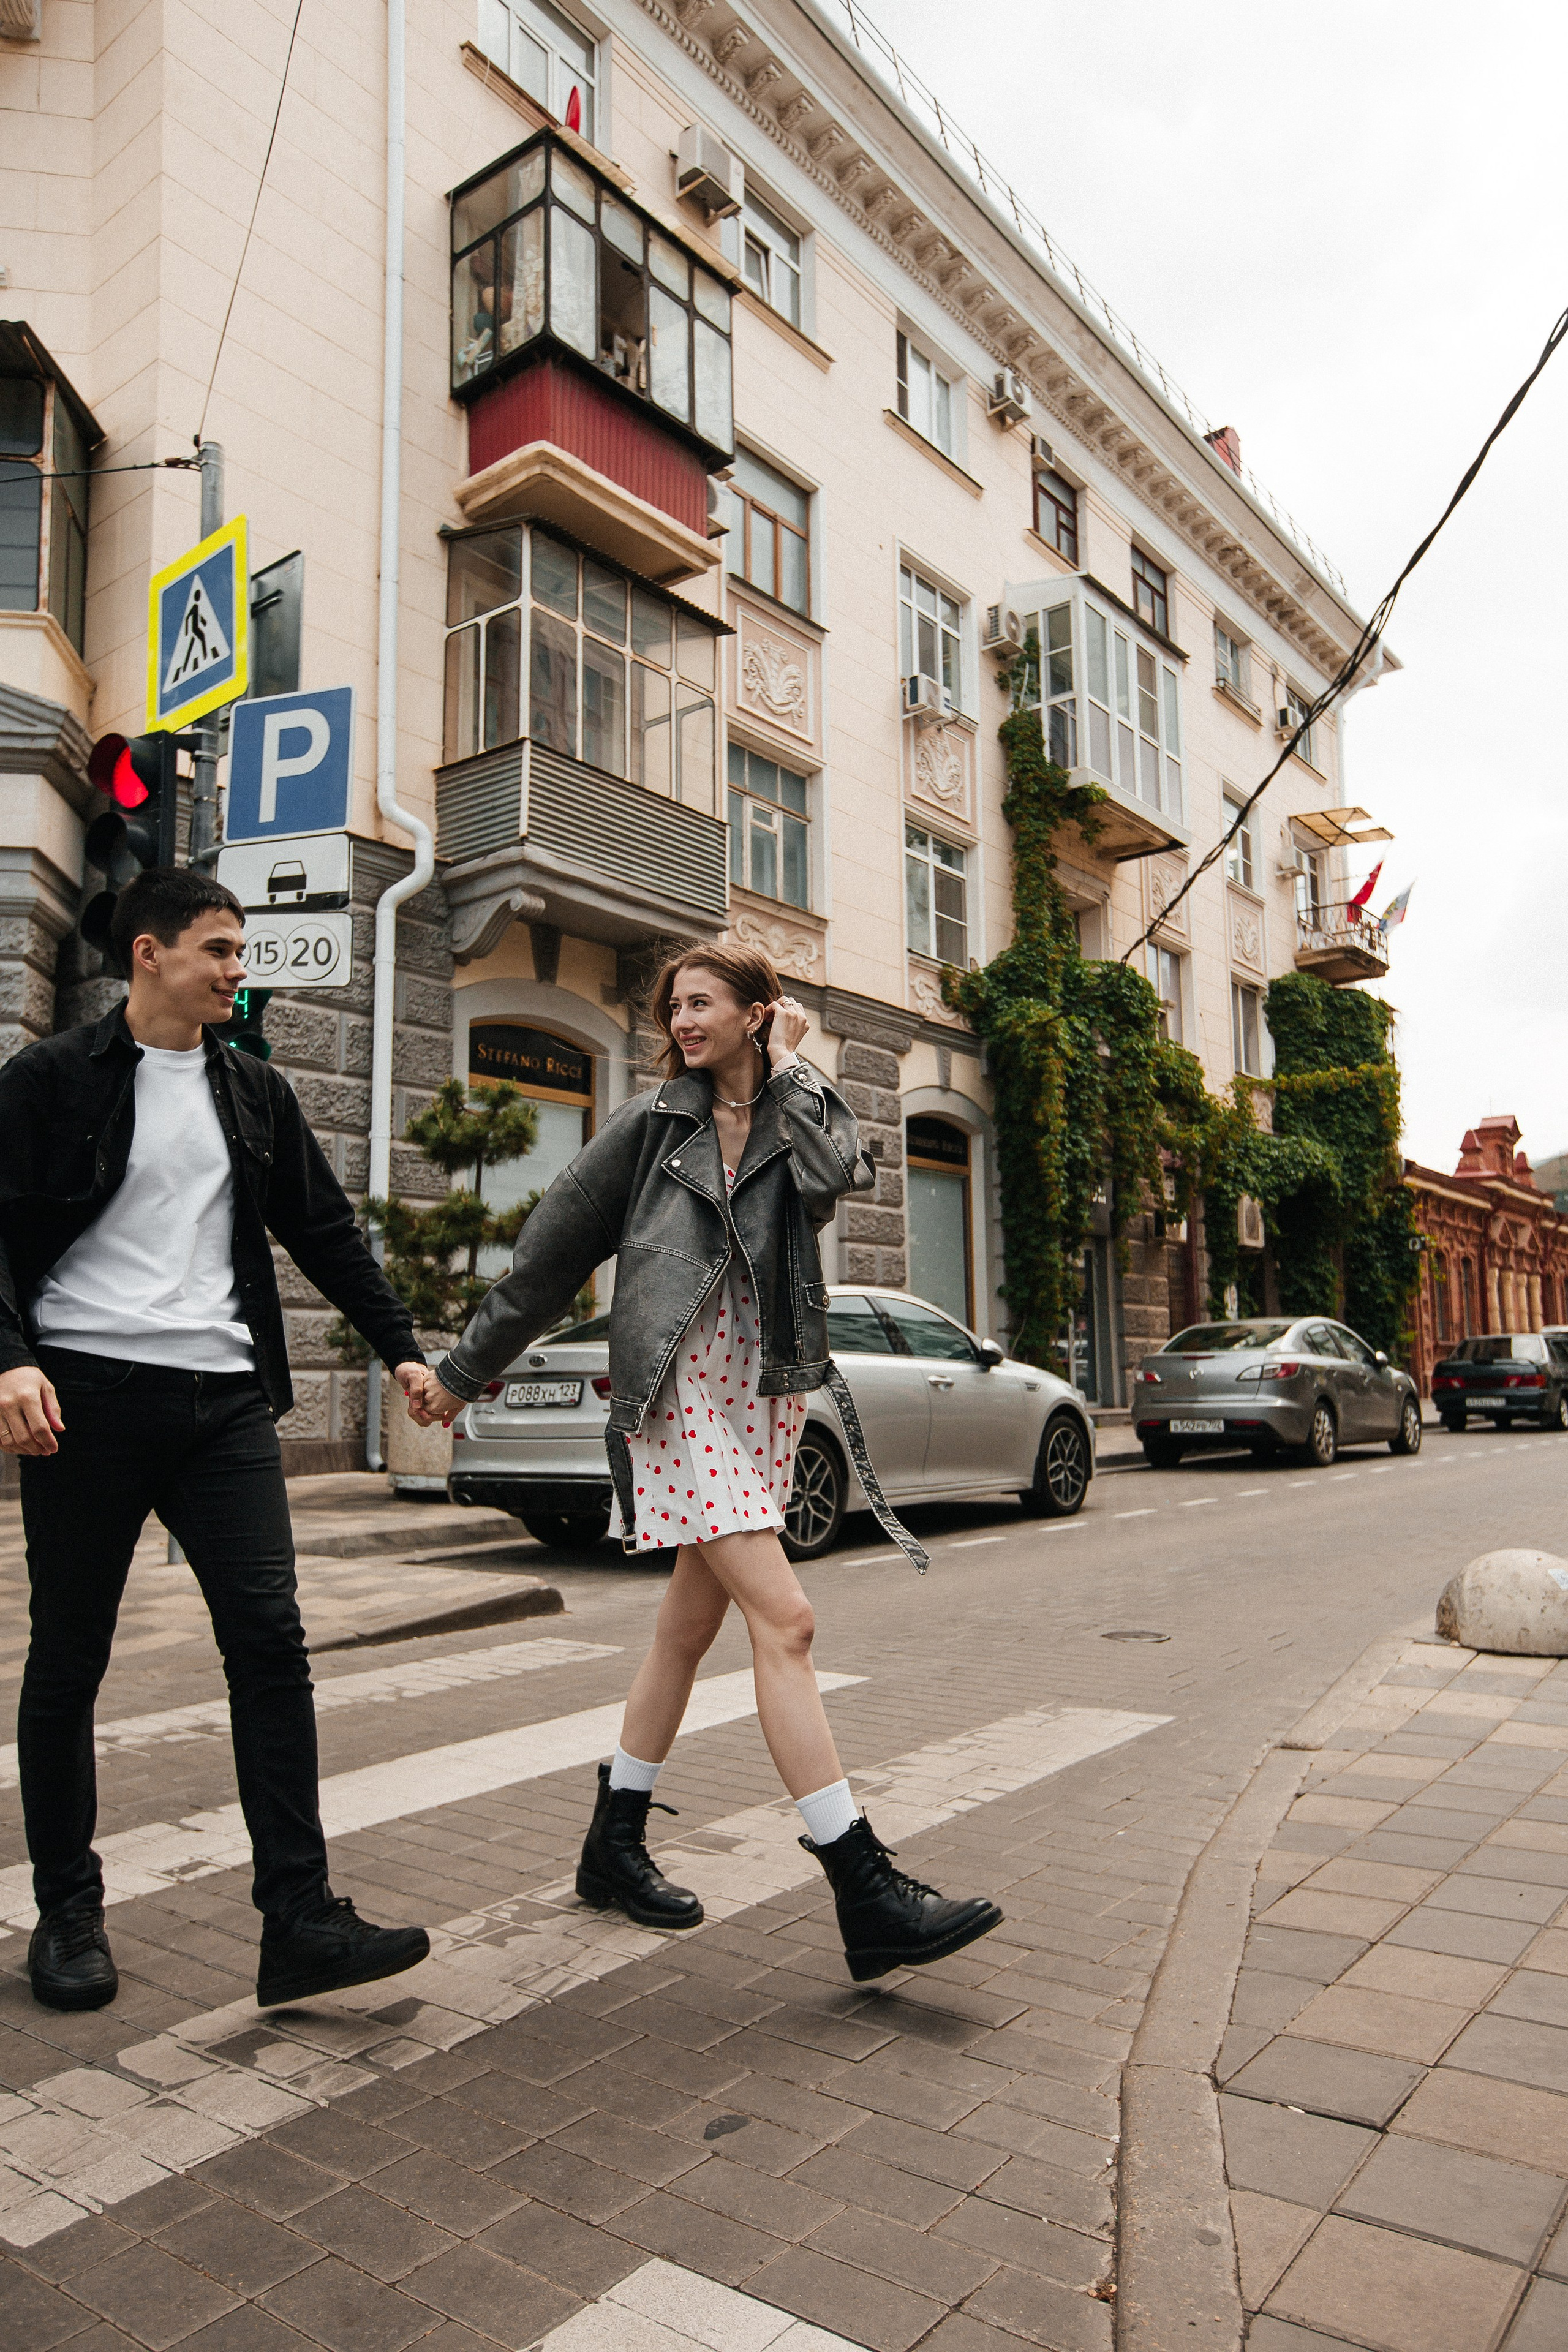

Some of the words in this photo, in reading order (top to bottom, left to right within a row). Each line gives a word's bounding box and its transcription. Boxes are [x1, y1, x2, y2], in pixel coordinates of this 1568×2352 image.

[258, 708, 331, 824] P
[253, 941, 279, 965] 15
[291, 937, 332, 967] 20
[478, 1042, 540, 1069] STEFANO
[546, 1057, 582, 1079] RICCI
[559, 1384, 577, 1397] 123
